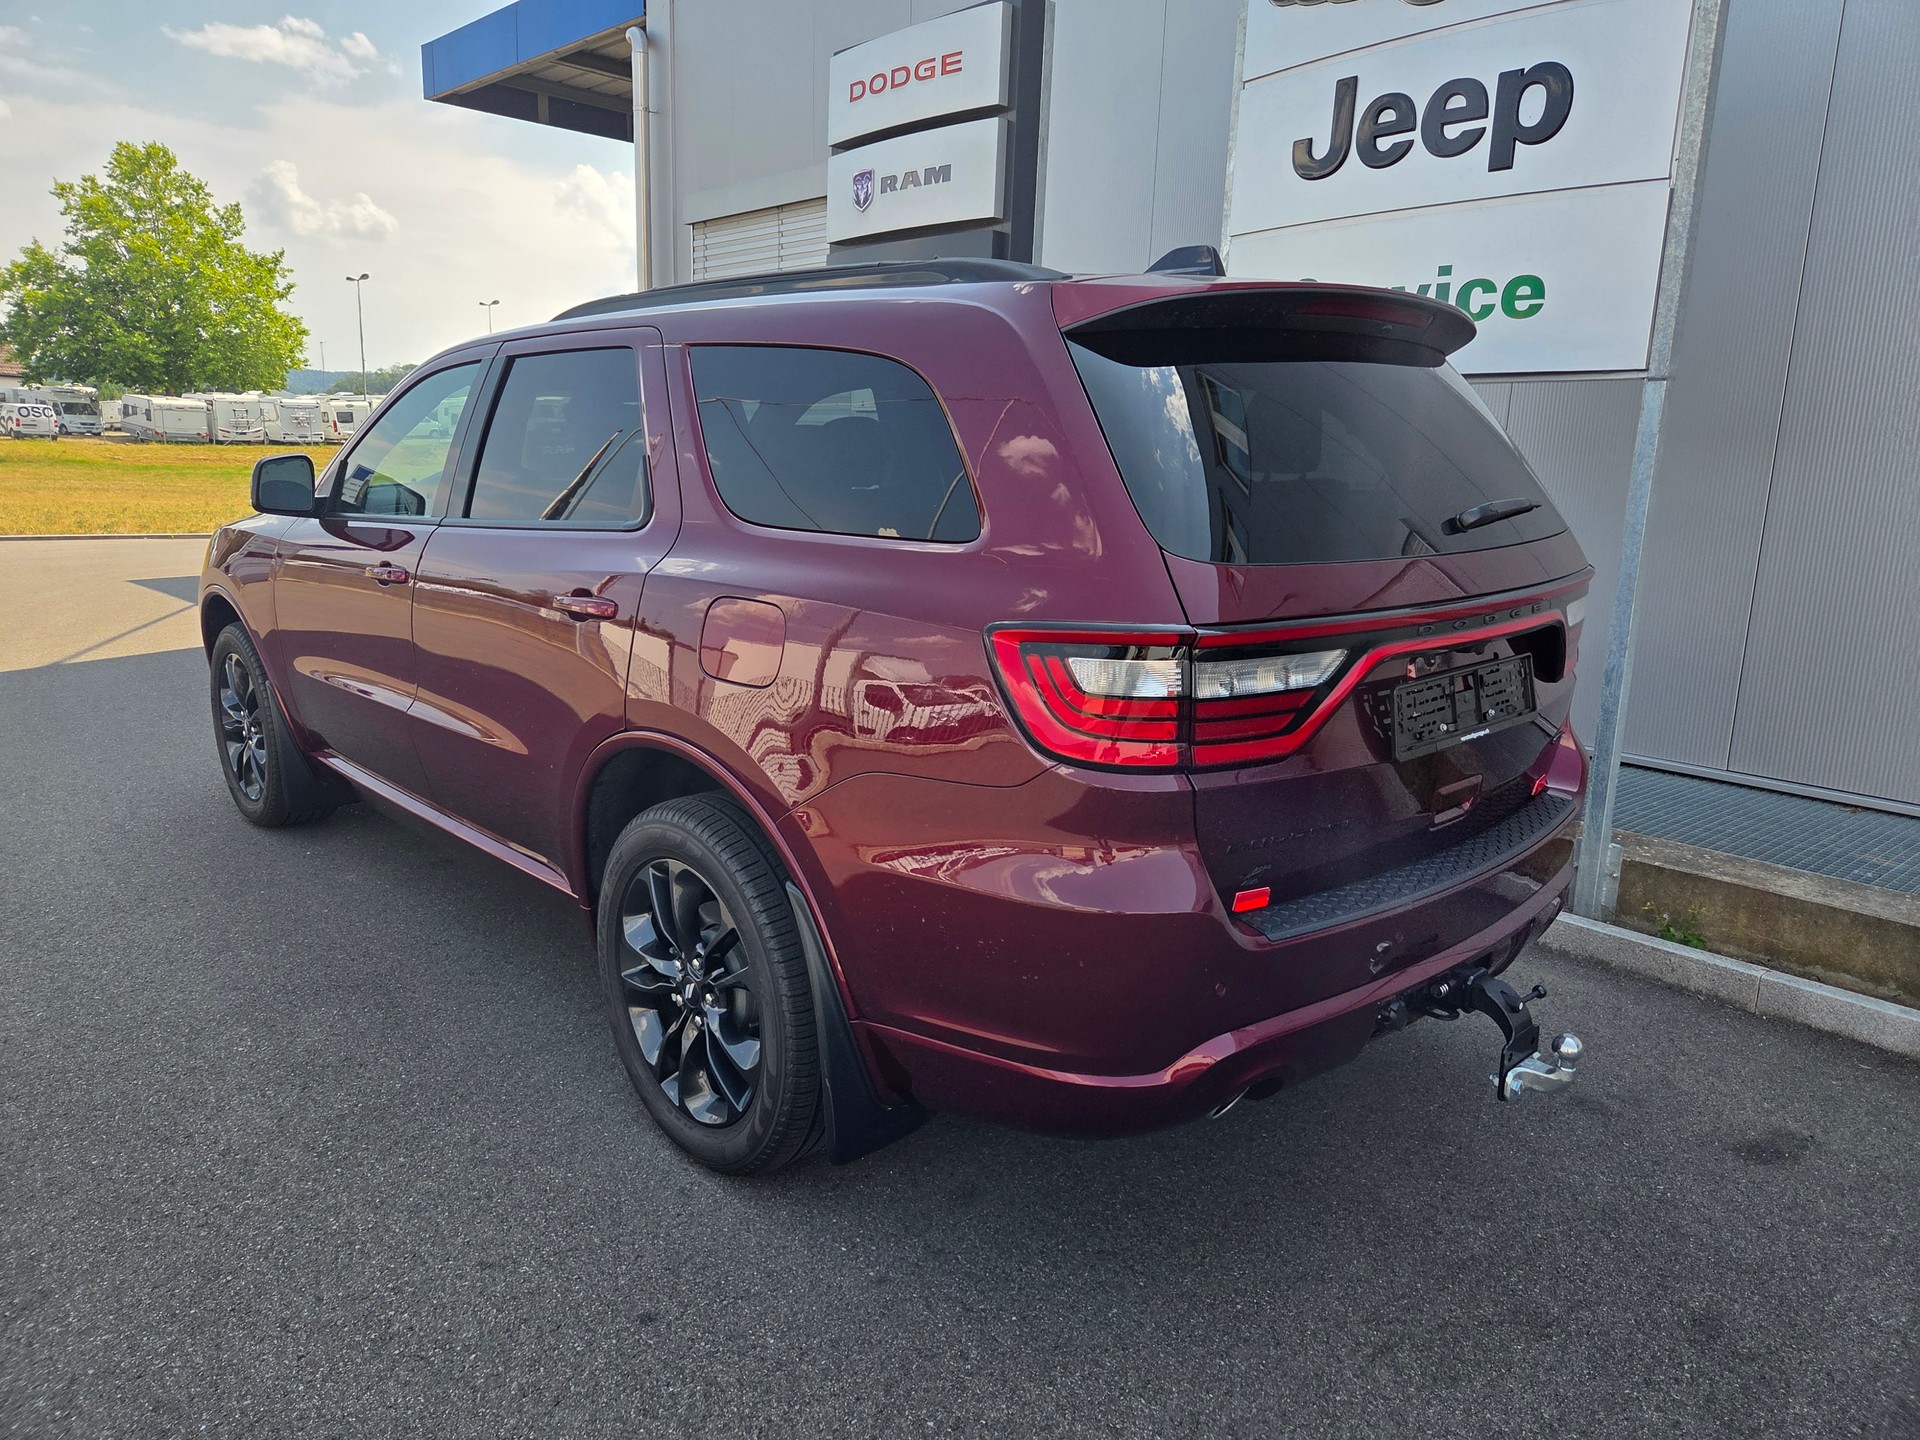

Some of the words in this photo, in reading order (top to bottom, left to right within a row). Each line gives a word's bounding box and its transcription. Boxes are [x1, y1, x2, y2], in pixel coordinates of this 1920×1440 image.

[849, 50, 963, 103] DODGE
[1291, 61, 1574, 181] Jeep
[880, 163, 952, 194] RAM
[17, 406, 54, 418] OSC
[1417, 603, 1542, 637] DODGE
